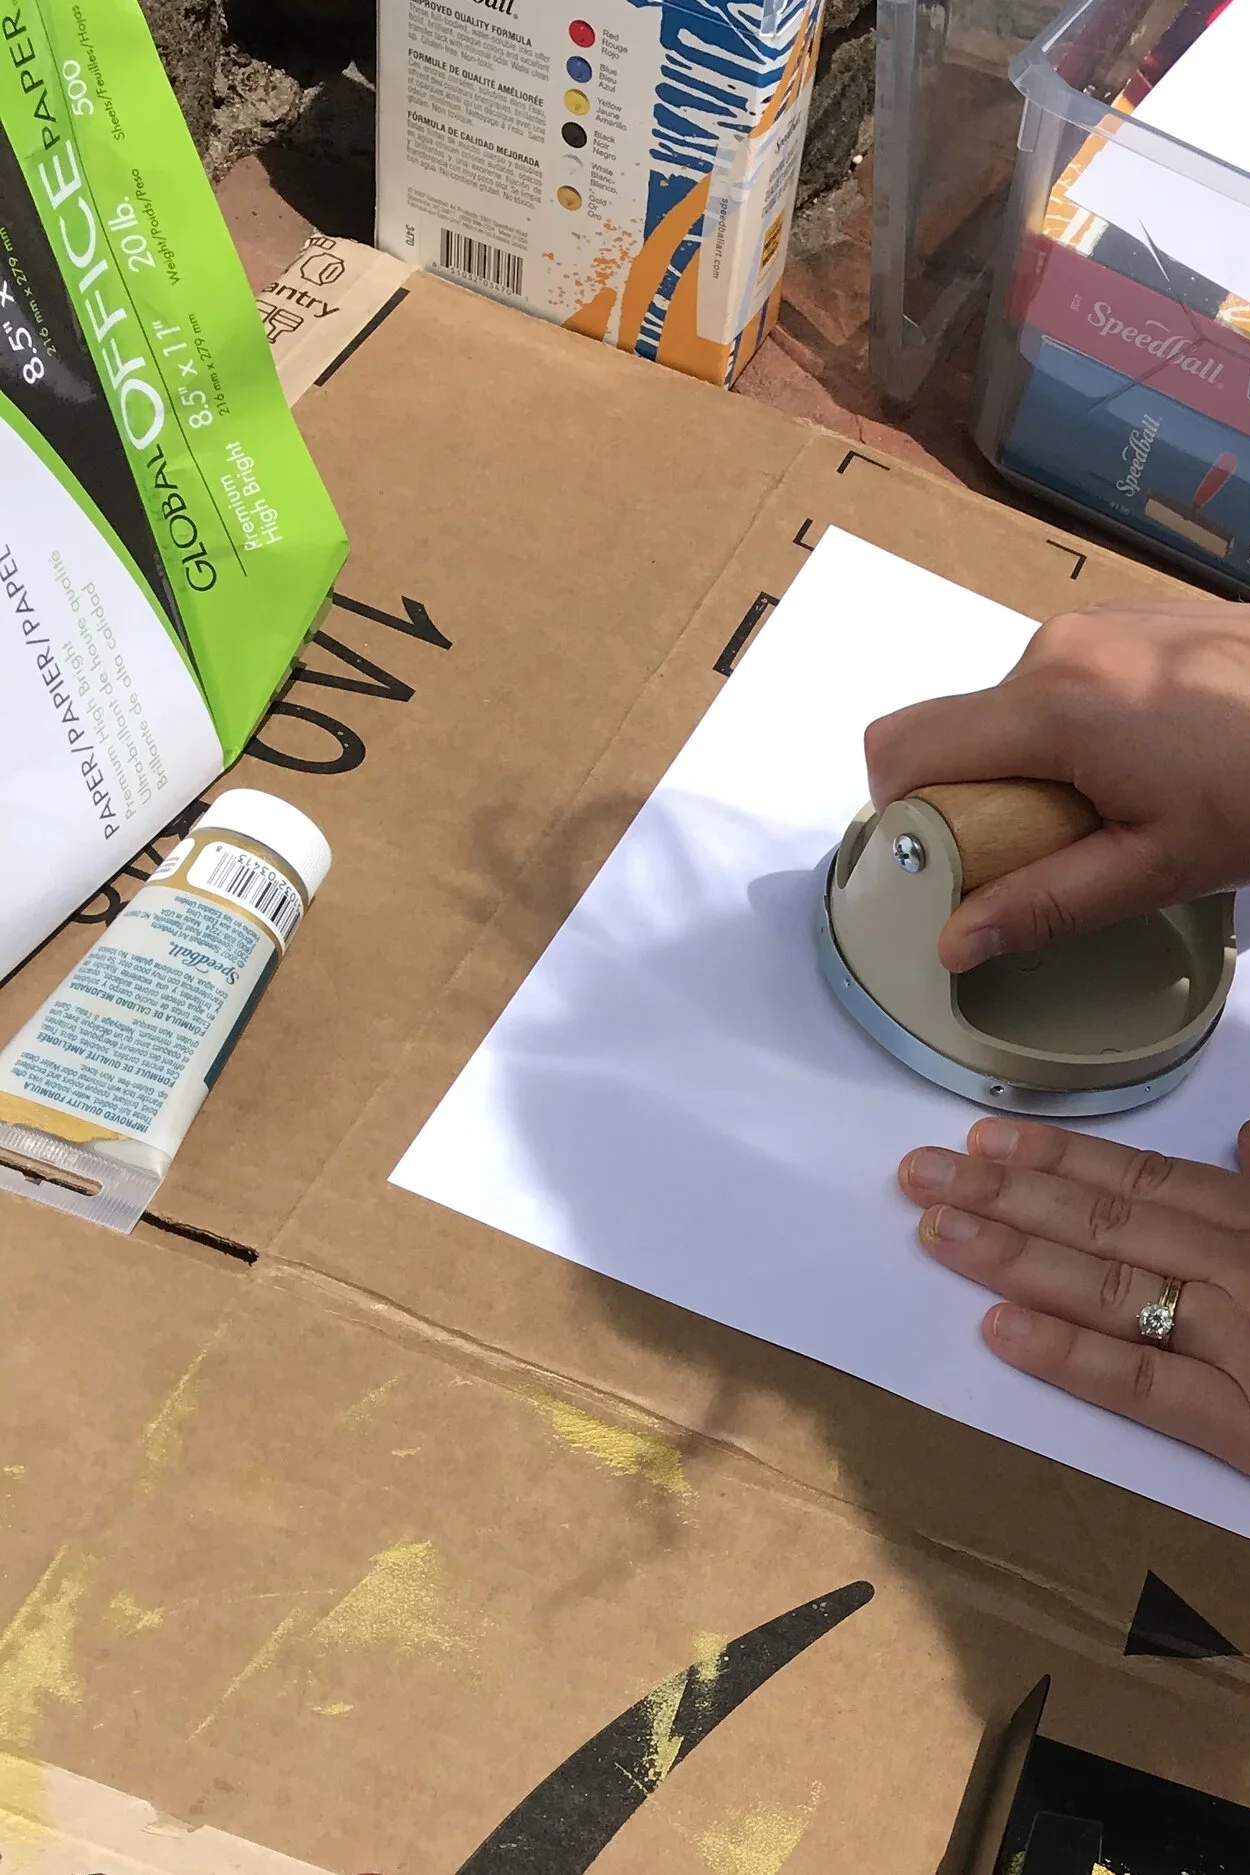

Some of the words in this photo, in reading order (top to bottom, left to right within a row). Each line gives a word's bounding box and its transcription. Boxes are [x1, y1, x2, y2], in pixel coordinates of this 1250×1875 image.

[410, 0, 453, 17] MPROVED
[454, 11, 490, 31] QUALITY
[491, 25, 533, 48] FORMULA
[602, 29, 619, 41] Red
[601, 38, 628, 53] Rouge
[601, 47, 620, 59] Rojo
[2, 8, 61, 150] PAPER
[72, 5, 125, 141] Sheets/Feuilles/Hojas
[408, 48, 447, 71] FORMULE
[449, 64, 460, 76] DE
[462, 69, 496, 90] QUALITÉ
[497, 83, 544, 108] AMÉLIORÉE
[599, 63, 617, 76] Blue
[63, 59, 95, 116] 500
[598, 81, 616, 93] Azul
[597, 97, 622, 112] Yellow
[407, 110, 446, 132] FÓRMULA
[448, 126, 458, 138] DE
[460, 131, 494, 151] CALIDAD
[496, 145, 539, 168] MEJORADA
[594, 130, 615, 144] Black
[592, 147, 616, 161] Negro
[589, 194, 607, 206] Gold
[108, 196, 139, 232] lb.
[132, 168, 181, 286] Weight/Poids/Peso
[405, 224, 415, 246] 3470
[711, 198, 729, 280] speedballart.com
[120, 234, 156, 273] 20
[8, 256, 28, 286] 279
[0, 279, 15, 308] x
[38, 139, 165, 450] OFFICE
[29, 299, 44, 325] mm
[188, 313, 202, 336] mm
[39, 326, 57, 357] 216
[152, 320, 188, 358] 11"
[194, 337, 212, 362] 279
[1088, 301, 1219, 387] Speedball
[3, 321, 45, 385] 8.5"
[178, 359, 198, 377] x
[211, 371, 224, 392] mm
[177, 386, 213, 430] 8.5"
[216, 393, 231, 417] 216
[1115, 413, 1161, 498] Speedball
[225, 441, 261, 498] Bright
[146, 444, 217, 592] GLOBAL
[220, 474, 264, 552] Premium
[251, 498, 283, 545] High
[48, 549, 81, 613] qualité
[81, 580, 118, 651] calidad
[77, 615, 102, 670] haute
[62, 640, 92, 698] Bright
[113, 654, 132, 688] alta
[99, 670, 113, 696] de
[129, 691, 143, 717] de
[87, 695, 110, 745] High
[108, 699, 152, 806] Ultra-brillant
[139, 719, 169, 791] Brillante
[106, 744, 137, 821] Premium
[160, 908, 176, 918] USA
[183, 915, 201, 927] Made
[184, 925, 202, 937] Road
[201, 932, 233, 952] Speedball
[189, 936, 221, 954] Speedball
[169, 945, 239, 985] Speedball
[70, 982, 115, 1002] MEJORADA
[115, 997, 151, 1015] CALIDAD
[152, 1010, 164, 1019] DE
[165, 1014, 206, 1037] FÓRMULA
[37, 1032, 86, 1055] AMÉLIORÉE
[85, 1051, 121, 1069] QUALITÉ
[121, 1063, 134, 1073] DE
[135, 1067, 176, 1088] FORMULE
[24, 1082, 66, 1102] FORMULA
[66, 1098, 103, 1116] QUALITY
[103, 1111, 148, 1133] IMPROVED
